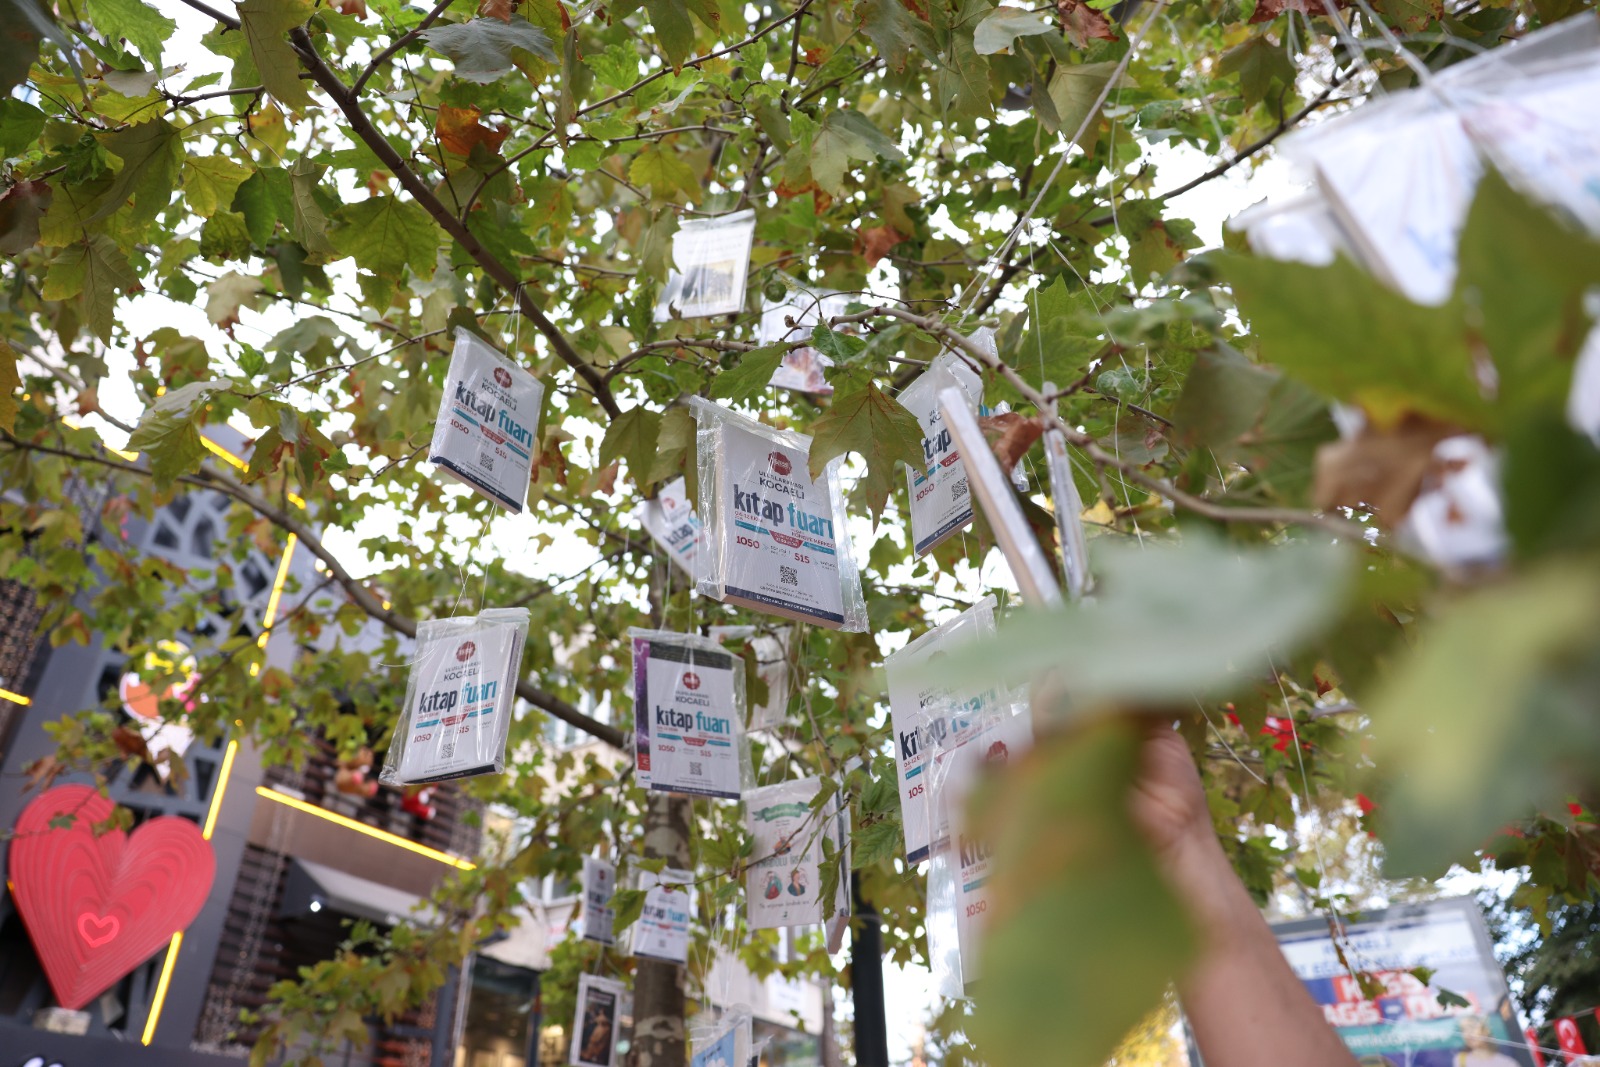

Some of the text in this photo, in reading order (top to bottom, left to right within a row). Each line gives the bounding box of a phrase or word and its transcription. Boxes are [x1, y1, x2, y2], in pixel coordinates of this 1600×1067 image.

[456, 381, 496, 423] kitap
[498, 409, 532, 448] fuarı
[450, 418, 469, 435] 1050
[924, 428, 952, 460] tap
[495, 447, 507, 460] 515
[916, 483, 934, 502] 1050
[734, 484, 833, 539] kitap fuarı
[736, 536, 760, 549] 1050
[794, 553, 810, 563] 515
[418, 689, 457, 714] kitap
[460, 680, 497, 706] fuarı
[656, 705, 730, 734] kitap fuarı
[413, 733, 431, 743] 1050
[900, 718, 947, 761] kitap
[658, 744, 675, 753] 1050
[966, 900, 986, 917] 1050
